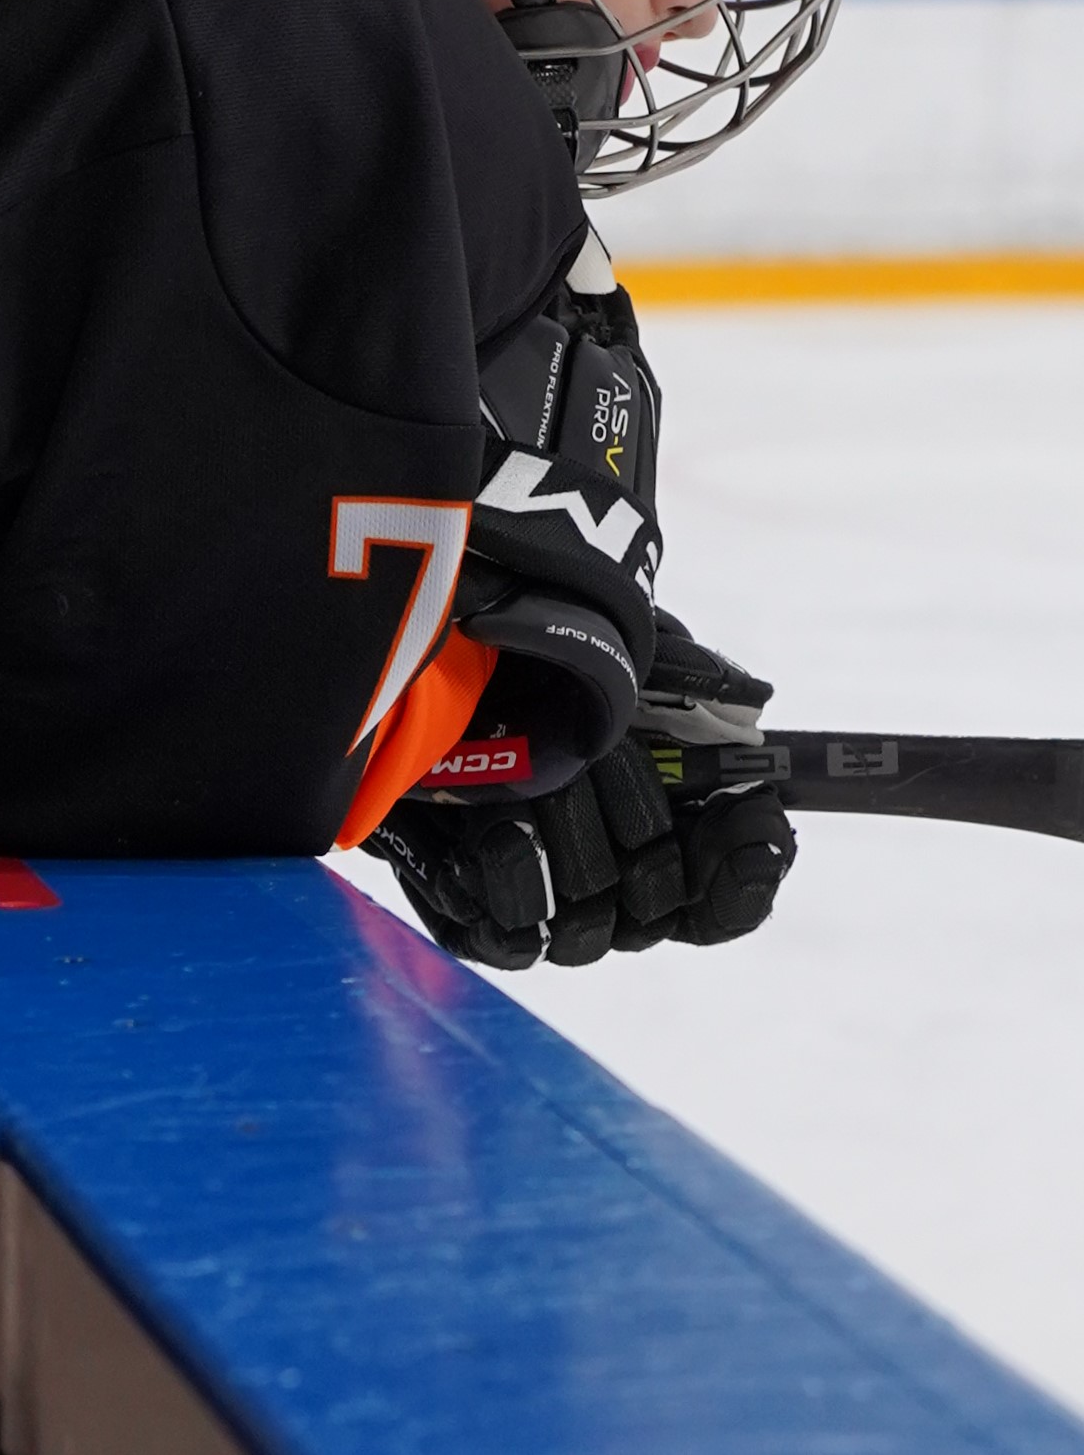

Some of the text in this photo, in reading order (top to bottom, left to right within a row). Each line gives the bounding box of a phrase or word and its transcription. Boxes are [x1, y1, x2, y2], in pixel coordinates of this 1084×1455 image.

[549, 341, 563, 374] PRO
[591, 387, 611, 444] PRO
[605, 371, 632, 478] AS-V
[544, 624, 588, 642] CUFF
[430, 750, 518, 775] CCM
